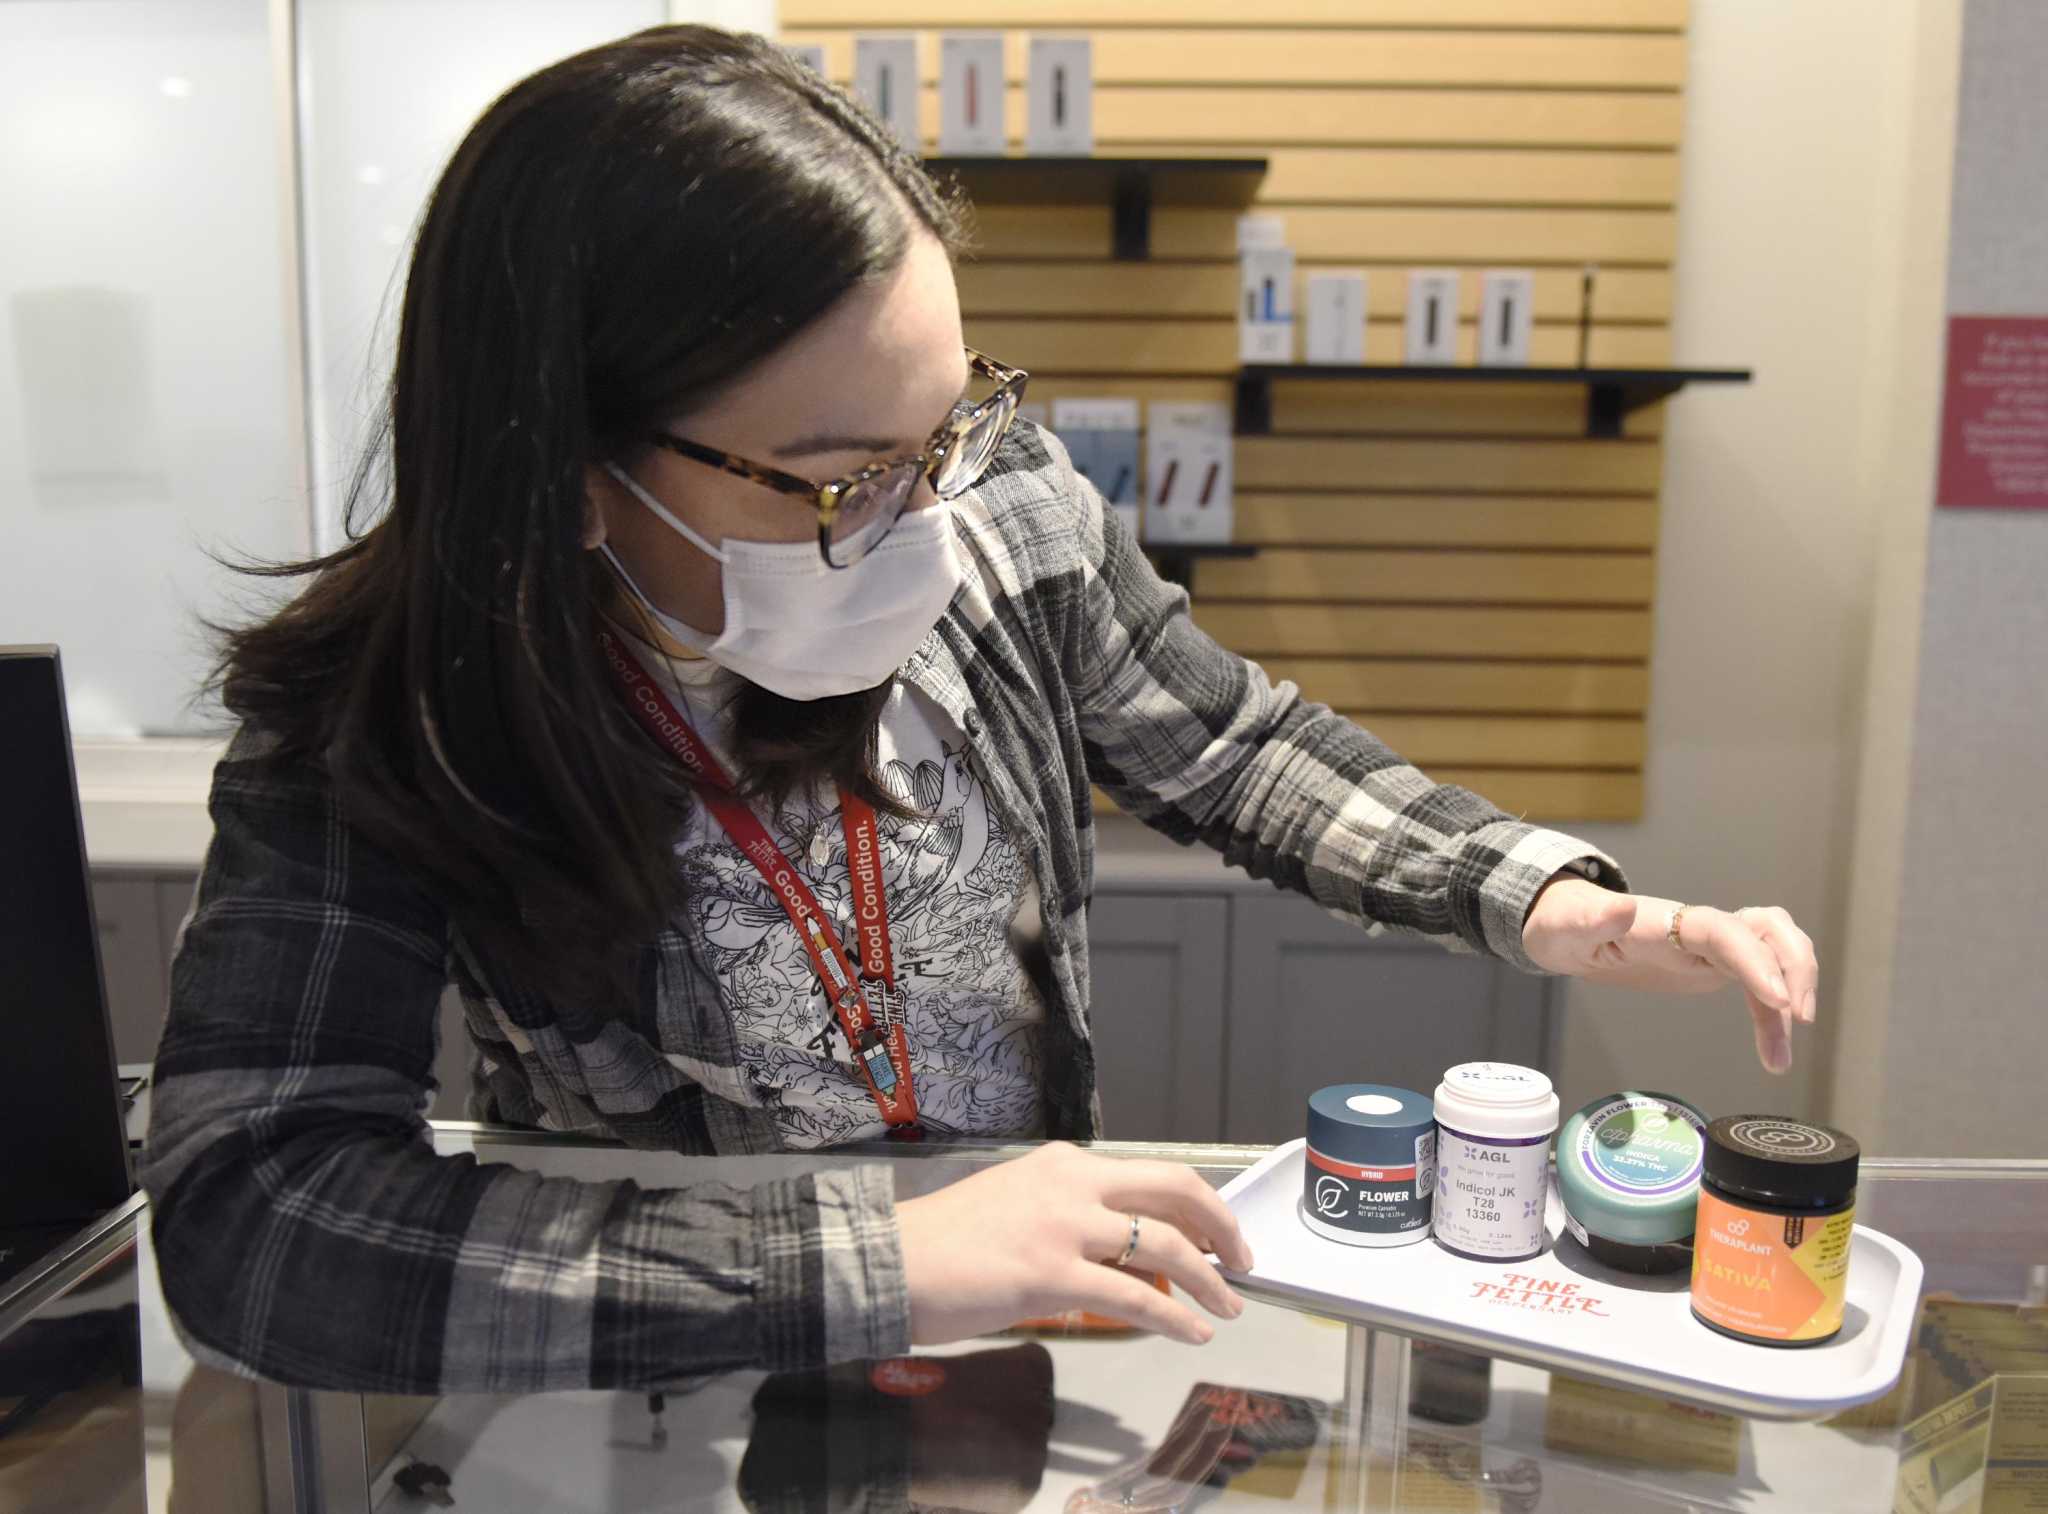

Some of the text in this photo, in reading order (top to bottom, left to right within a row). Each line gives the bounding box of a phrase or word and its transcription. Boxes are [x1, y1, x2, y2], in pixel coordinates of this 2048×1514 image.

[775, 870, 813, 918] Good
[854, 819, 885, 973] Good Condition.
[1479, 1150, 1511, 1163] AGL
[1361, 1170, 1384, 1179] HYBRID
[1648, 1161, 1668, 1172] THC
[1359, 1190, 1409, 1202] FLOWER
[1456, 1179, 1516, 1198] Indicol JK
[1473, 1196, 1495, 1209] T28
[1465, 1208, 1501, 1222] 13360
[1704, 1257, 1772, 1292] SATIVA
[1503, 1273, 1581, 1295] FINE
[1469, 1282, 1610, 1316] FETTLE
